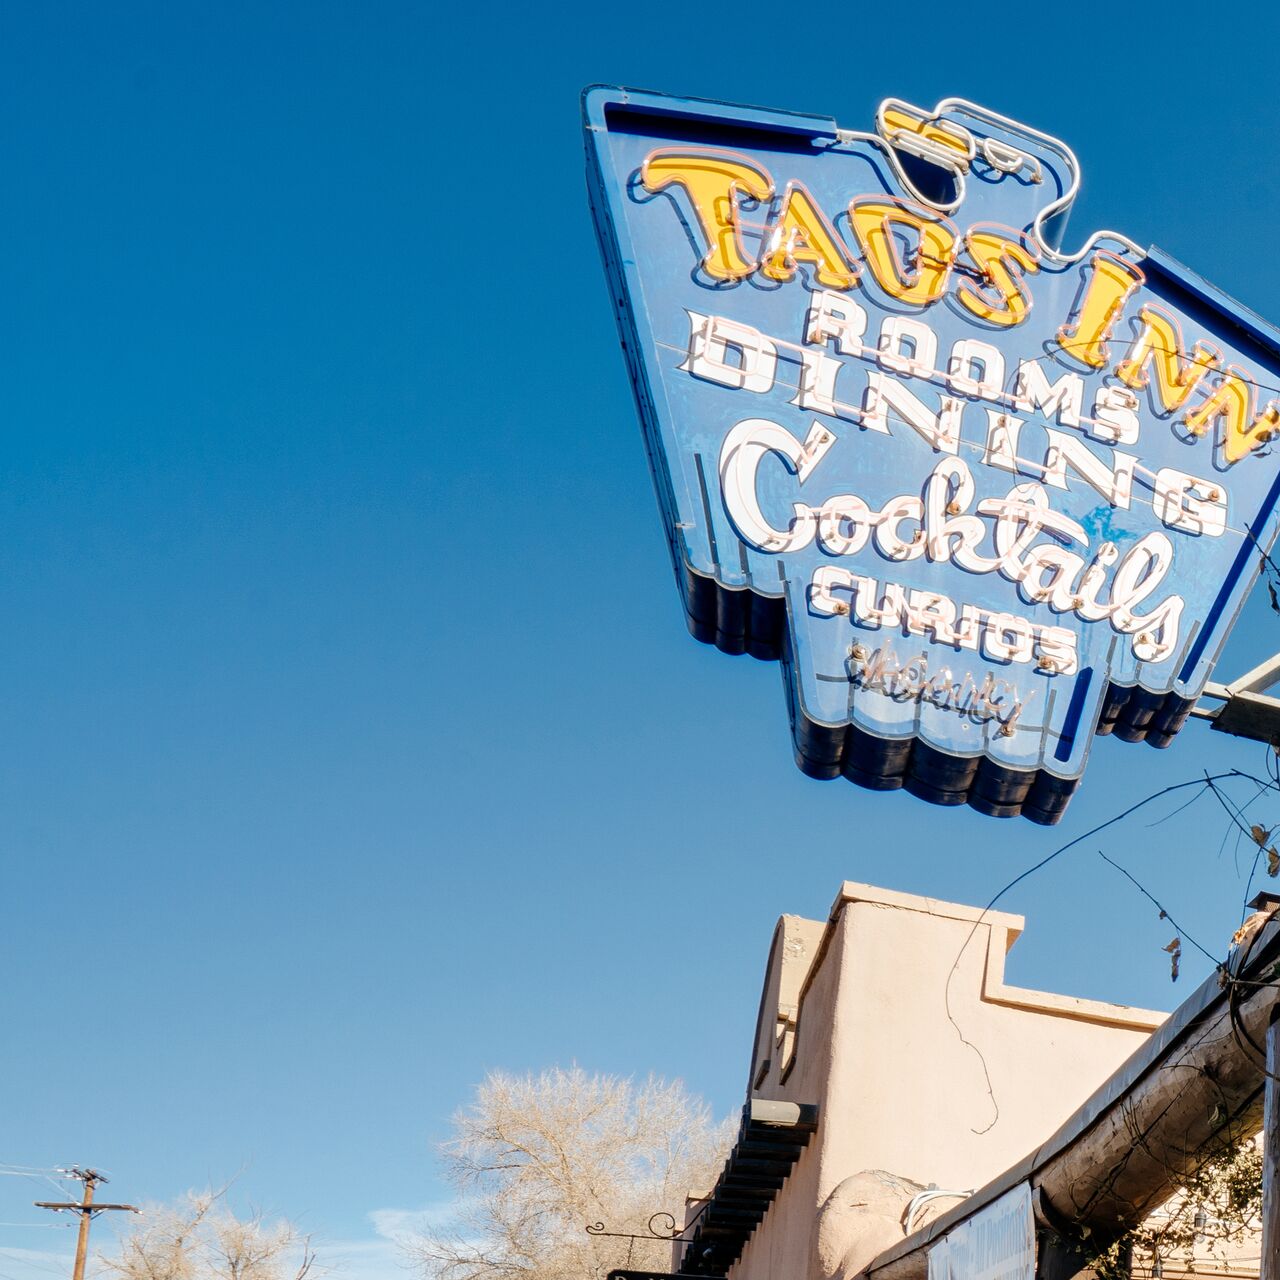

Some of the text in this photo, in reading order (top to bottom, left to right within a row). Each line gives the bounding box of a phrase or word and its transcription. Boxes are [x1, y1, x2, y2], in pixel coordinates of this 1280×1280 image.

[641, 146, 1042, 327] TAOS
[676, 308, 1229, 538] DINING
[808, 288, 1141, 446] ROOMS
[718, 417, 1185, 663] Cocktails
[811, 565, 1079, 677] CURIOS
